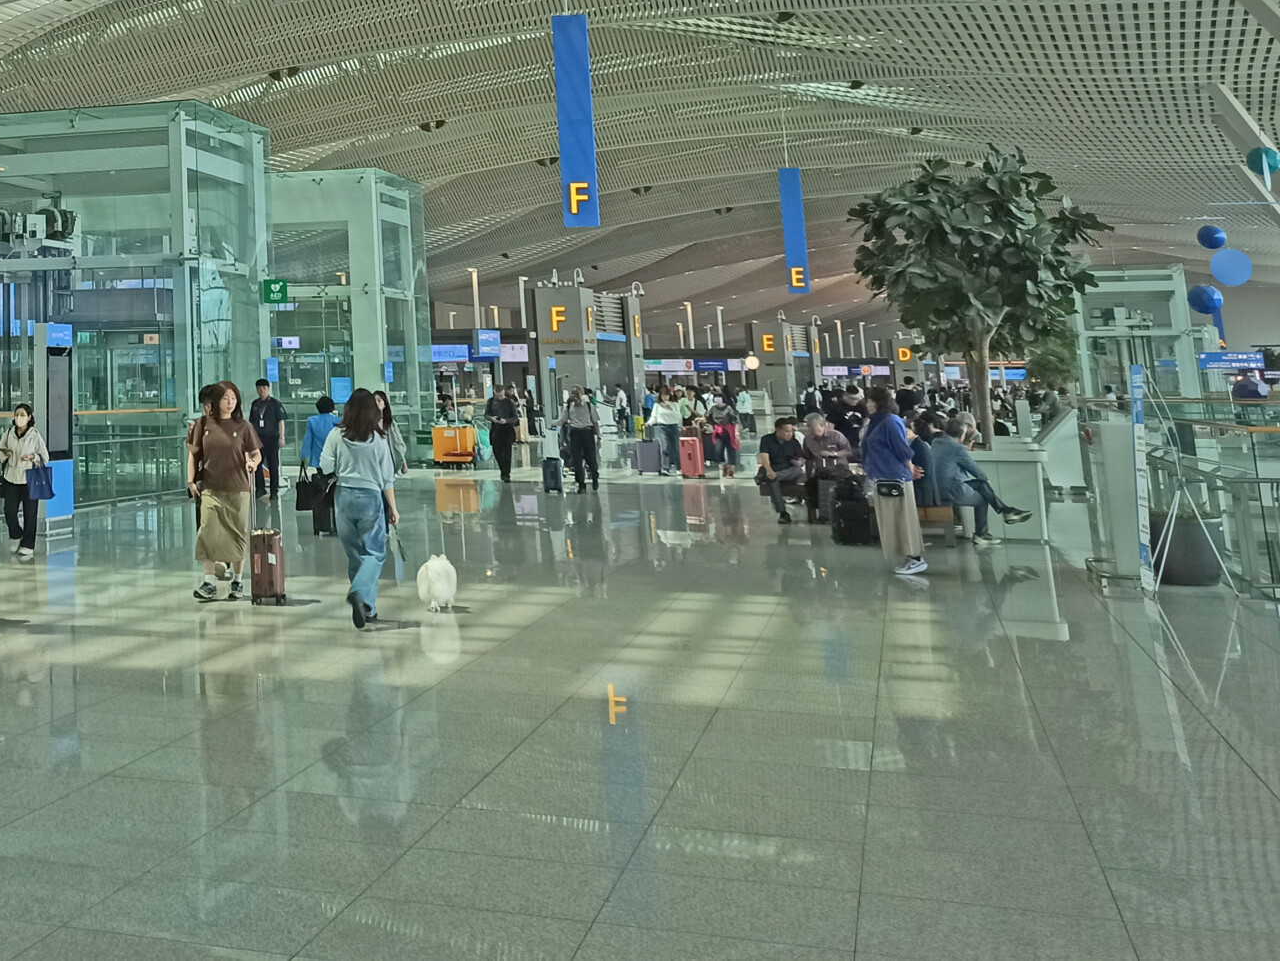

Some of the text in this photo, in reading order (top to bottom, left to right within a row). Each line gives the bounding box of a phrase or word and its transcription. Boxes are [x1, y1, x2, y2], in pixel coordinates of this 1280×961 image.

[569, 182, 589, 214] F
[791, 267, 805, 287] E
[550, 306, 566, 331] F
[762, 335, 774, 351] E
[897, 347, 912, 361] D
